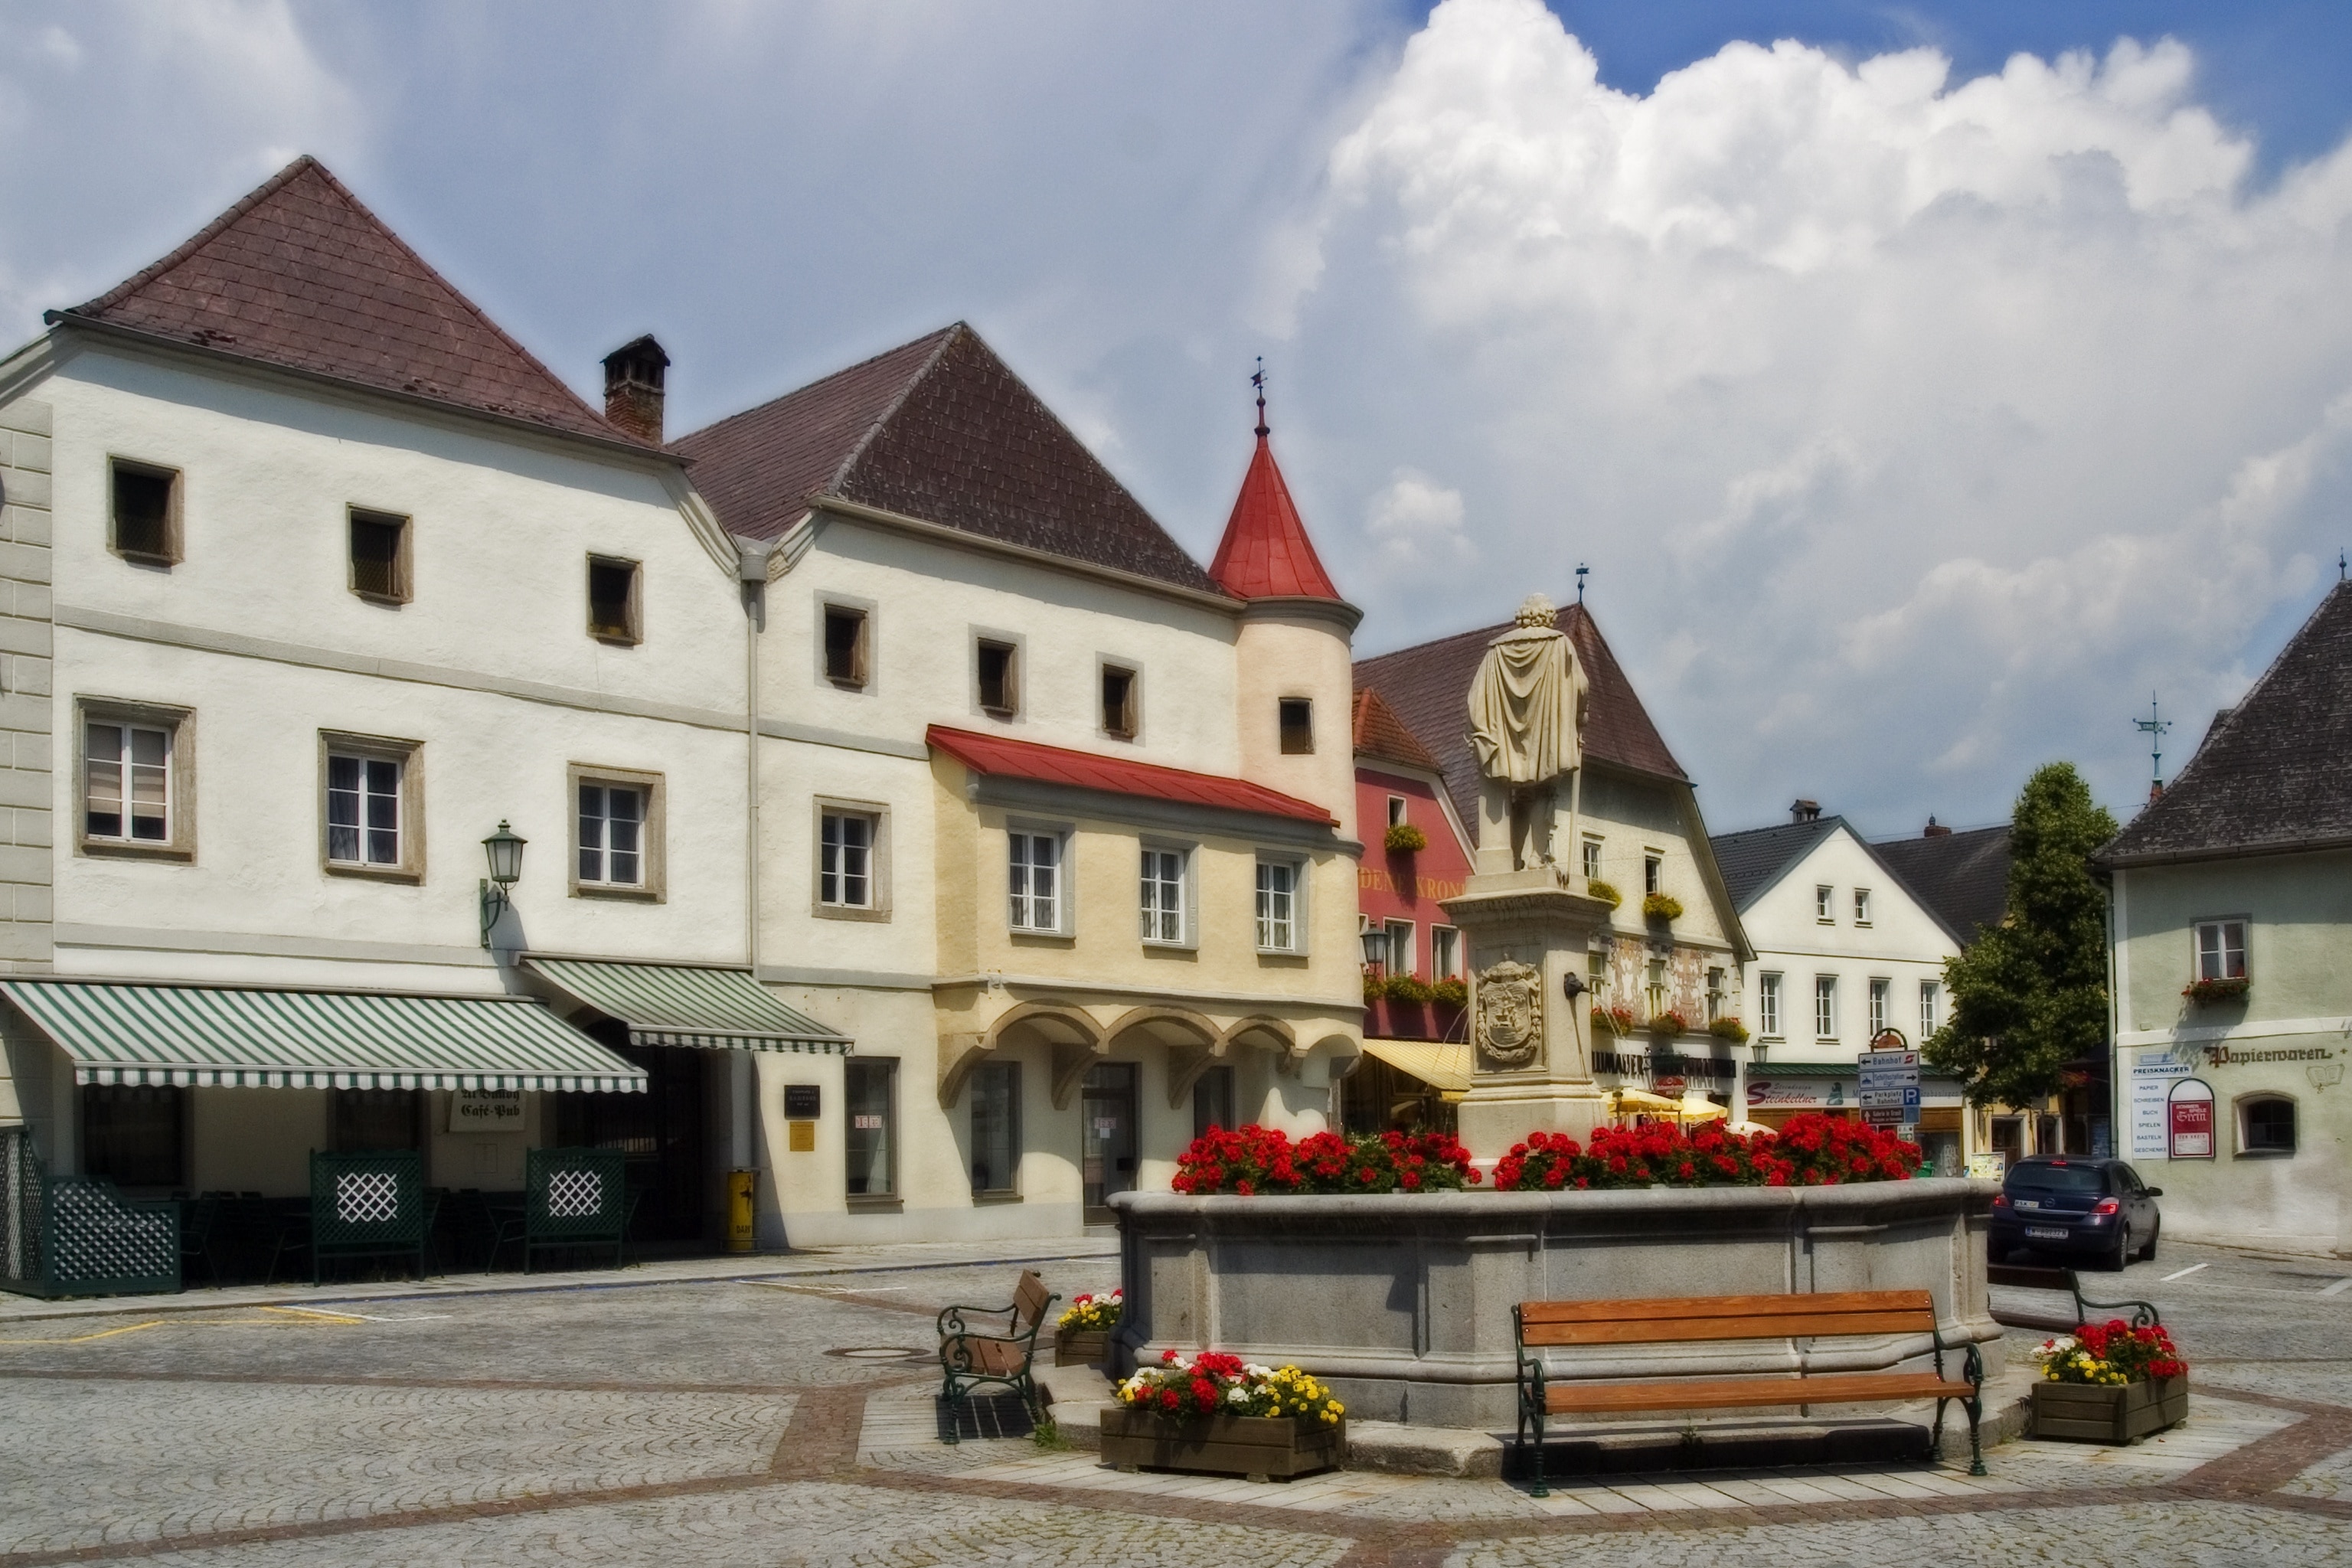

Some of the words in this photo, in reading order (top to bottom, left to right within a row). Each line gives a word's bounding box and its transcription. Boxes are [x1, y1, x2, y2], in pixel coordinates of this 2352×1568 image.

[1873, 1057, 1901, 1066] Bahnhof
[2203, 1047, 2333, 1068] Papierwaren
[1747, 1082, 1817, 1106] Steinkellner
[1874, 1091, 1902, 1099] Parkplatz
[1906, 1089, 1916, 1102] P
[461, 1104, 520, 1119] Café-Pub
